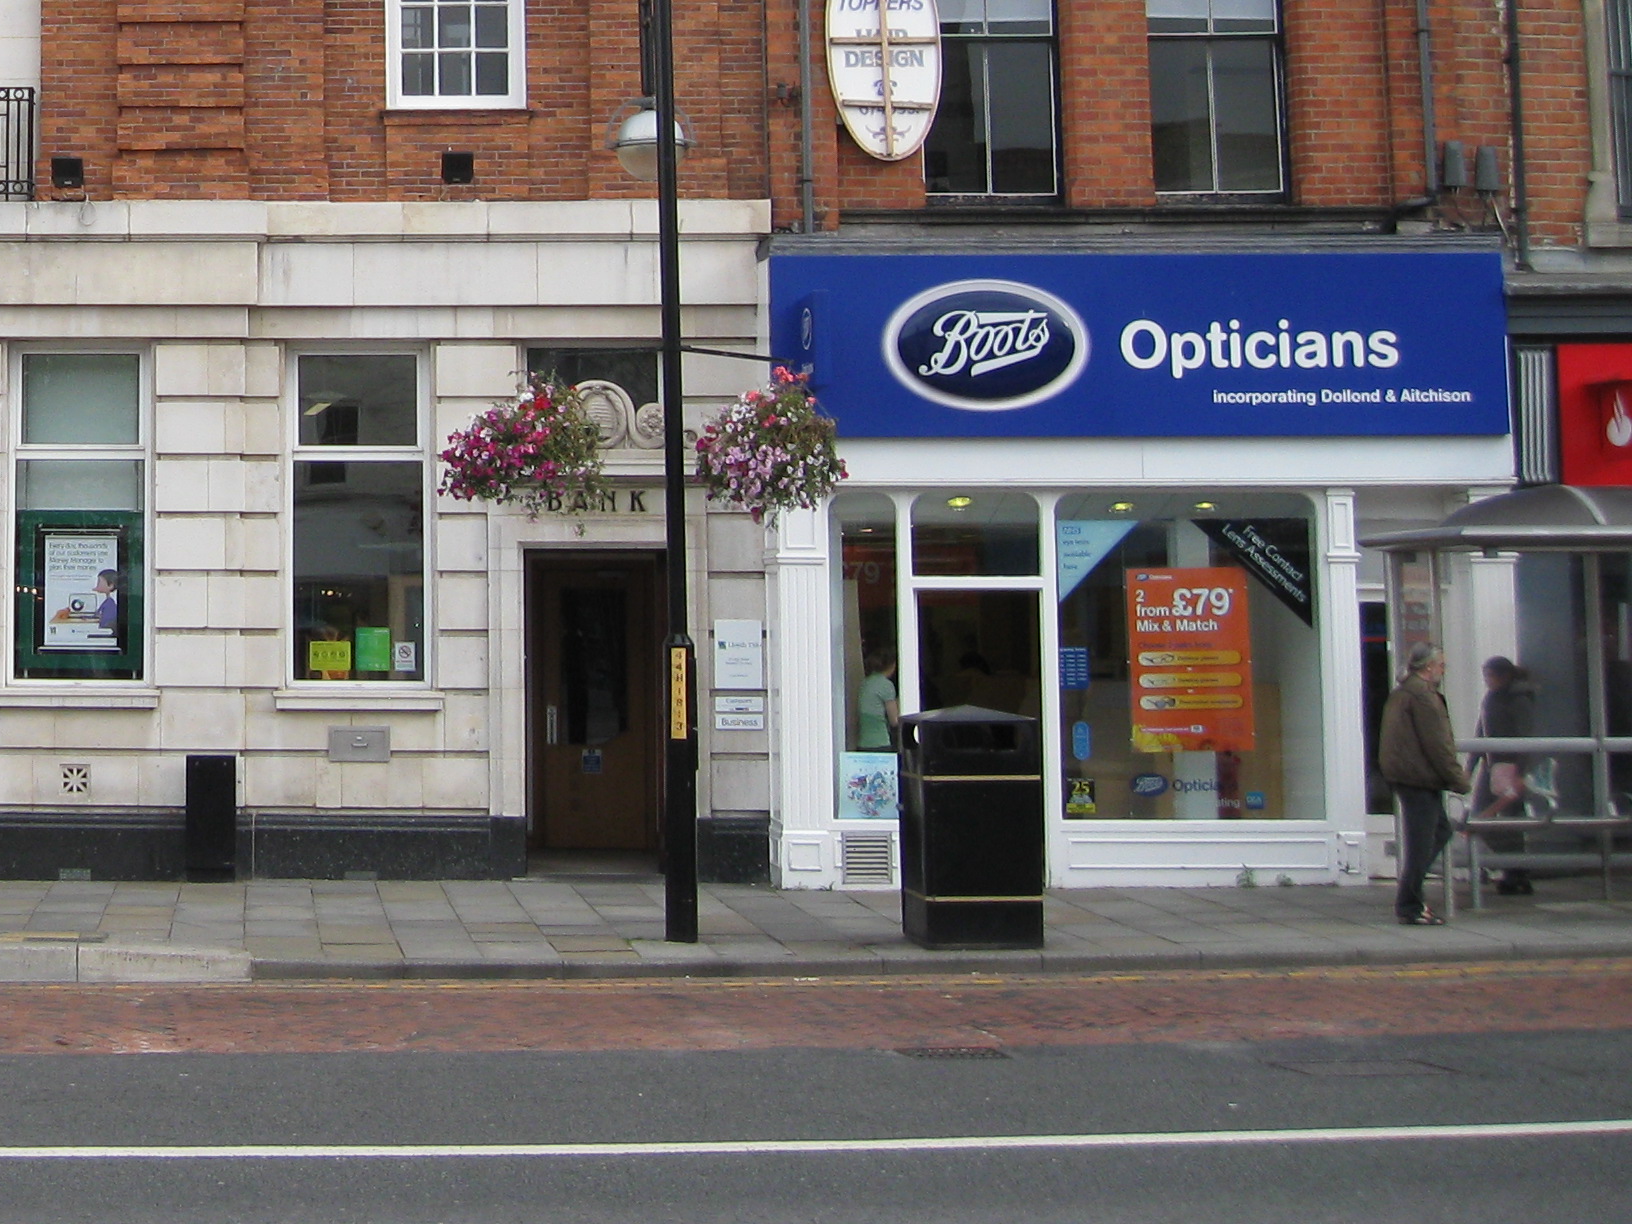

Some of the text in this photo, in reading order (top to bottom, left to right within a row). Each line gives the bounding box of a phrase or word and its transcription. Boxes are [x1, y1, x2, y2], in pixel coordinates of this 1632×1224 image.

[844, 50, 924, 67] DESIGN
[918, 309, 1399, 379] Boots Opticians
[1212, 388, 1472, 406] incorporating Dollond & Aitchison
[548, 490, 646, 512] BANK
[1243, 525, 1303, 581] Free Contact
[1222, 523, 1306, 602] Lens Assessments
[1135, 589, 1144, 602] 2
[1136, 604, 1169, 616] from
[1136, 619, 1218, 632] Mix & Match
[1072, 781, 1090, 795] 25
